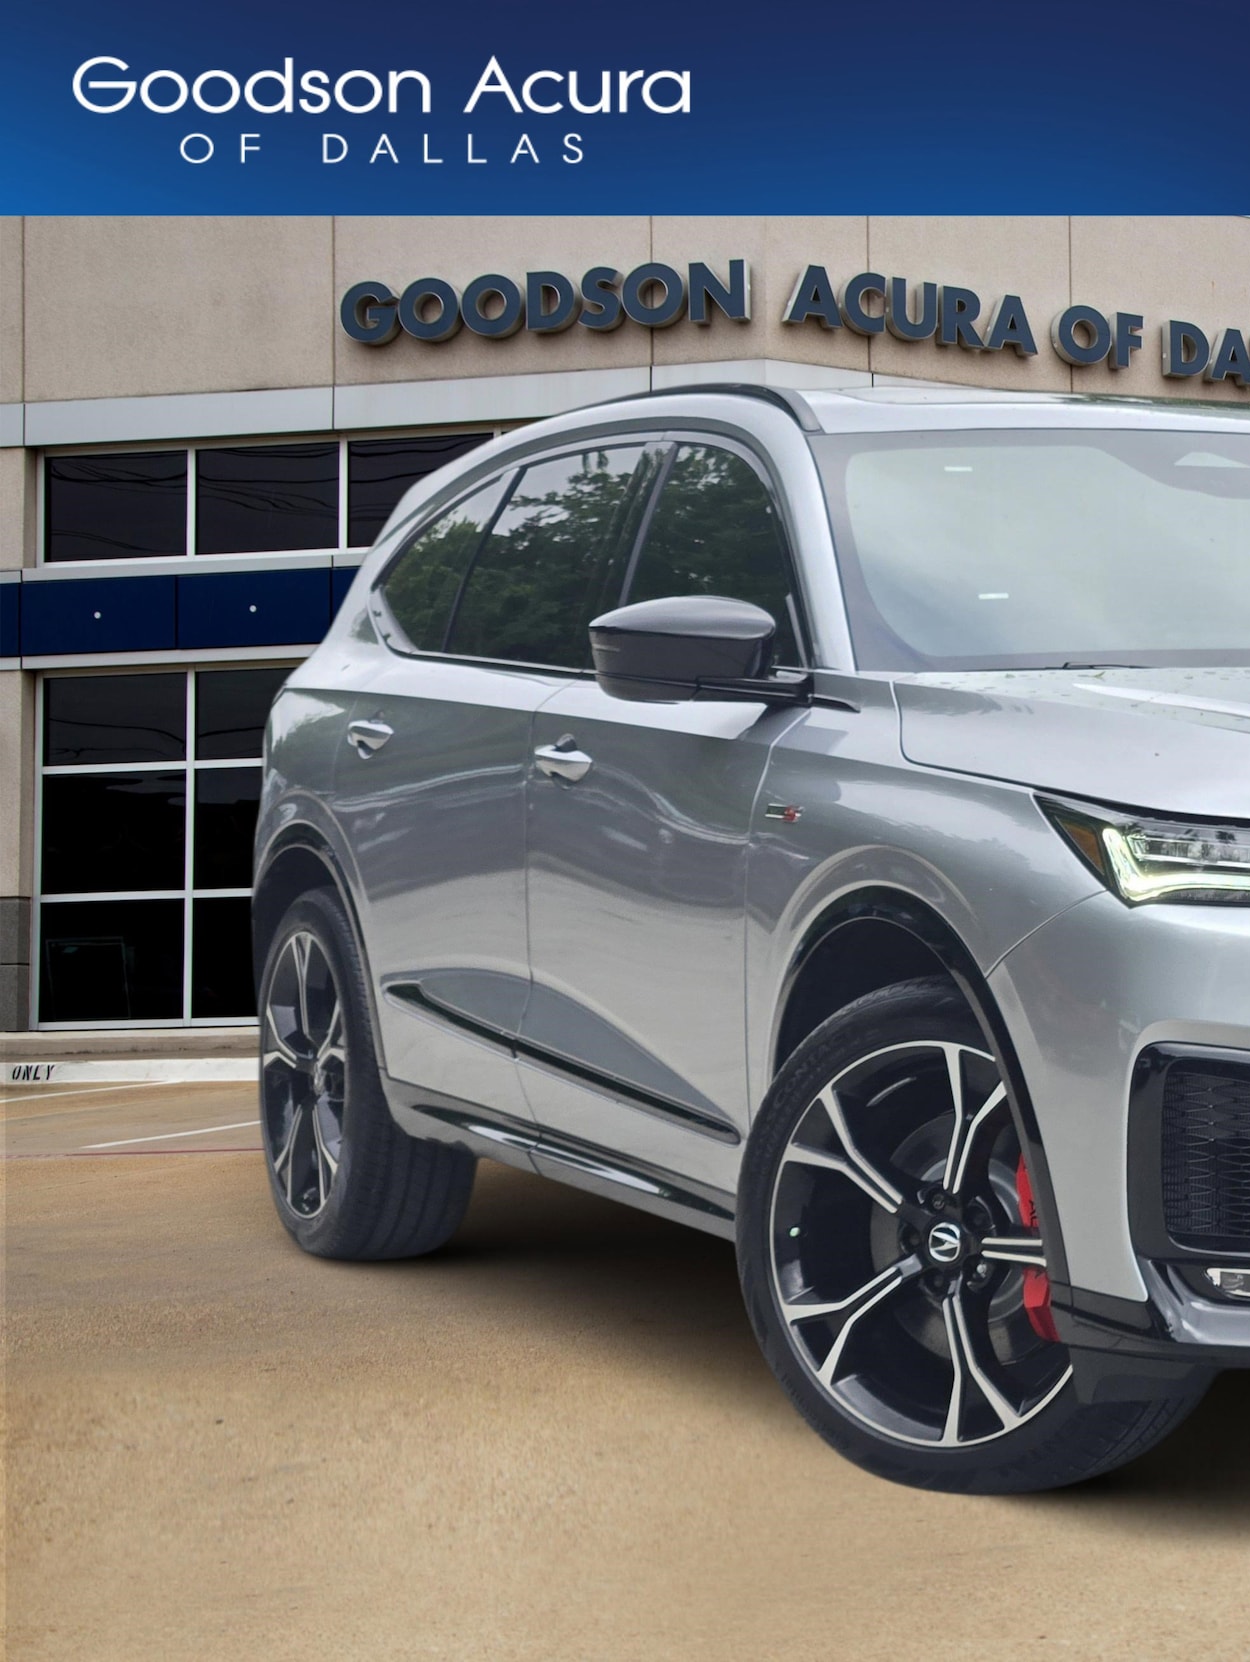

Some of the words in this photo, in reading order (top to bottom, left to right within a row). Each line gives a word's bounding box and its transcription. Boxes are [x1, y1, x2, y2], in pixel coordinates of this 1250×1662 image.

[340, 259, 750, 346] GOODSON
[782, 264, 1038, 357] ACURA
[1051, 305, 1144, 370] OF
[12, 1065, 55, 1080] ONLY
